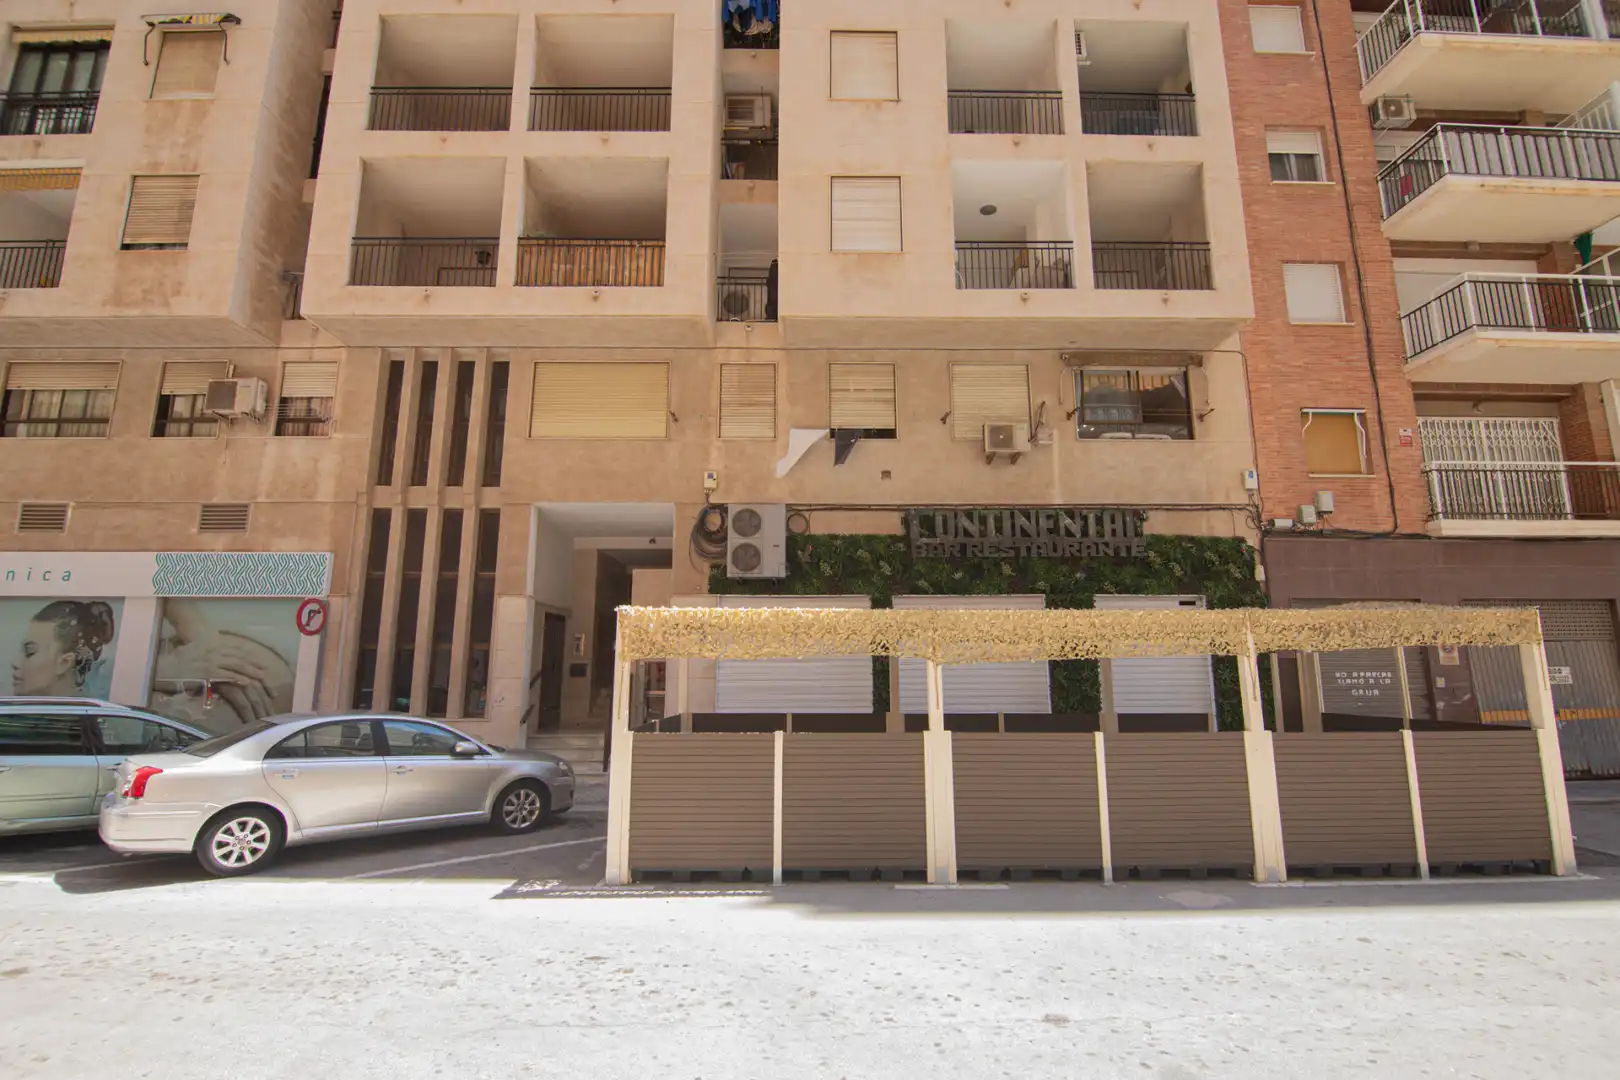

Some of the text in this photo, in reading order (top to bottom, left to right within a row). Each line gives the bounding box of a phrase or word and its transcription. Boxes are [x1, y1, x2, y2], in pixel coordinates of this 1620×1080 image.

[908, 507, 1142, 539] CONTINENTAL
[911, 539, 1146, 558] BAR RESTAURANTE
[5, 567, 71, 582] nica
[1351, 689, 1380, 697] GRUA
